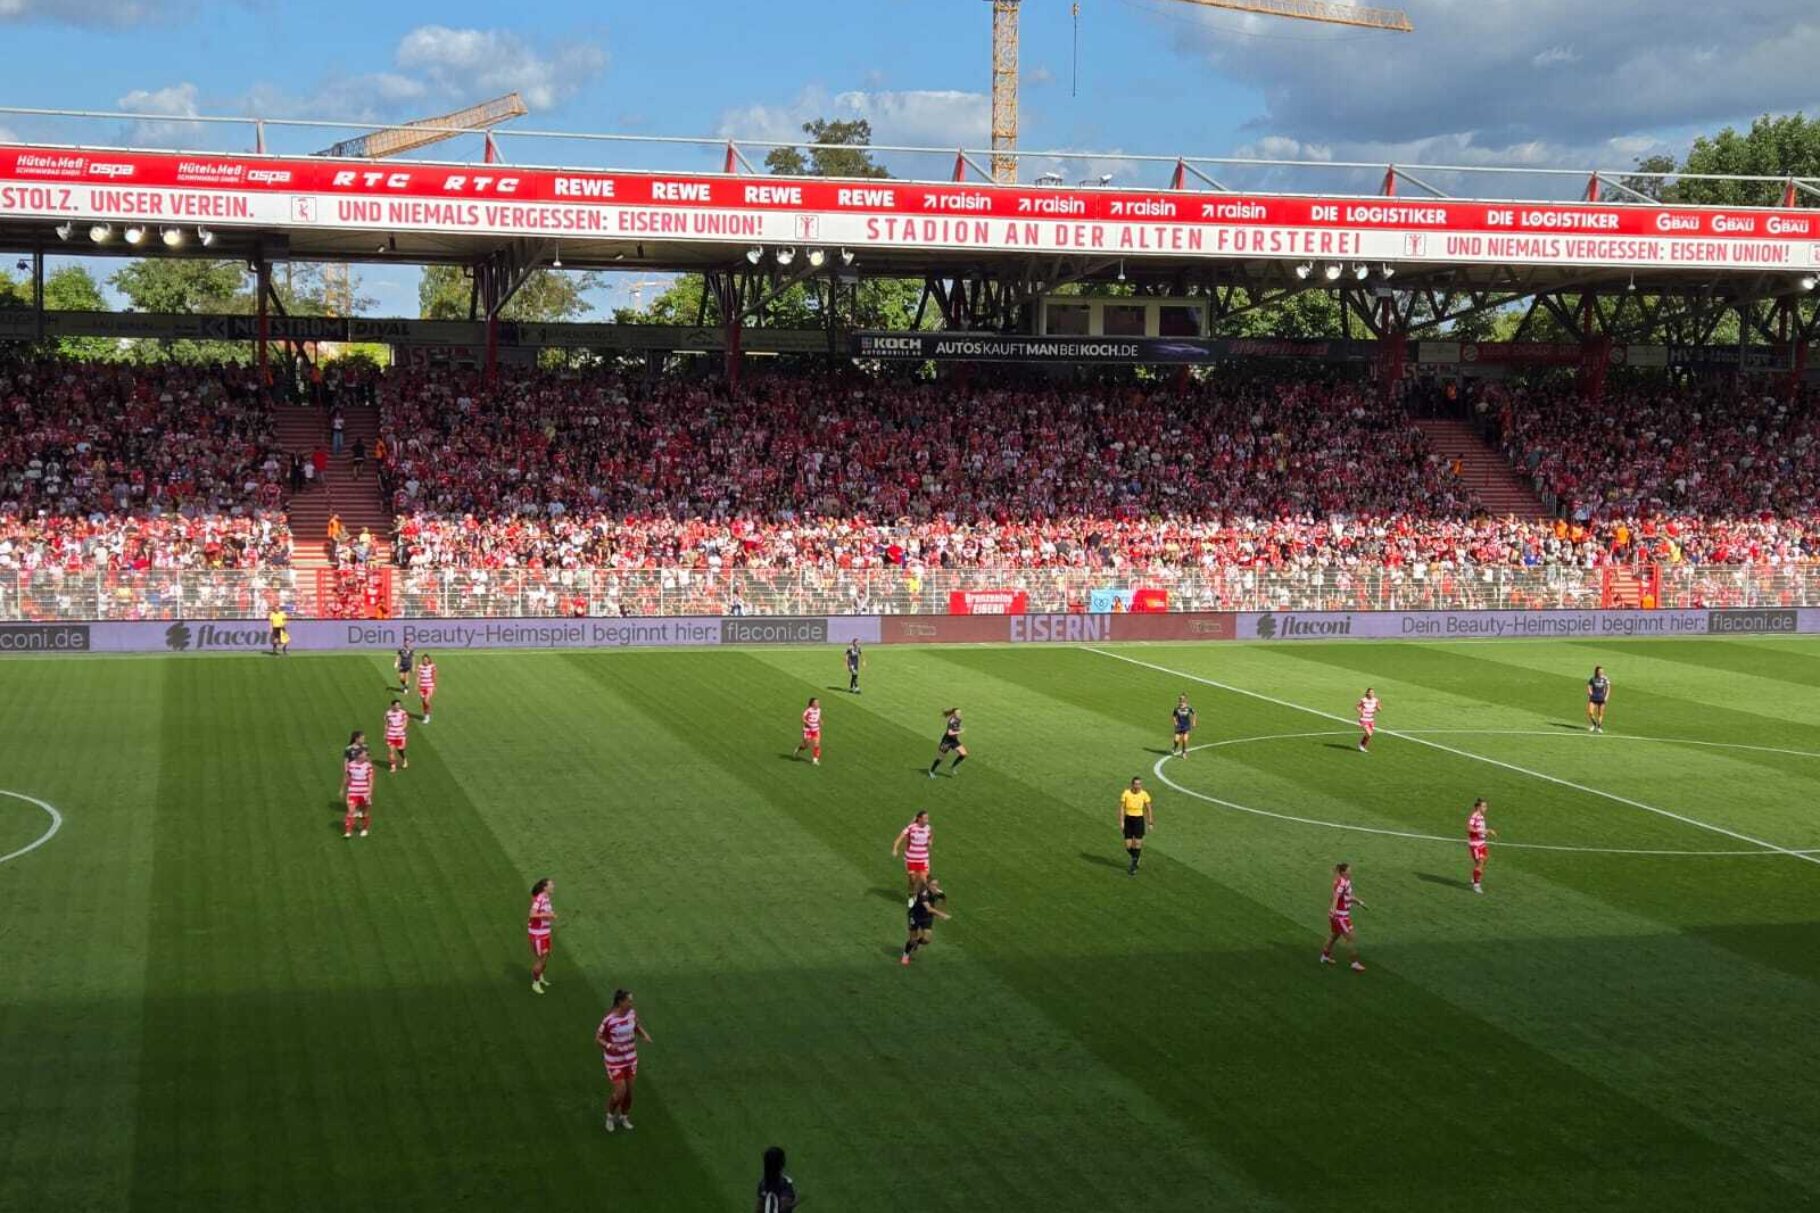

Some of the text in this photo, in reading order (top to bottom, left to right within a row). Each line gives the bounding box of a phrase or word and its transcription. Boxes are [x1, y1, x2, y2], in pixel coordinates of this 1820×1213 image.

[332, 170, 412, 188] RTC
[443, 175, 520, 192] RTC
[554, 178, 615, 198] REWE
[652, 181, 711, 201] REWE
[744, 185, 803, 204] REWE
[838, 188, 895, 207] REWE
[0, 187, 255, 218] STOLZ. UNSER VEREIN.
[939, 192, 992, 211] raisin
[1034, 196, 1085, 215] raisin
[1126, 197, 1176, 217] raisin
[1216, 201, 1267, 220] raisin
[338, 199, 763, 235] UND NIEMALS VERGESSEN: EISERN UNION!
[1310, 205, 1447, 225] DIE LOGISTIKER
[1487, 210, 1619, 229] DIE LOGISTIKER
[866, 217, 1360, 255] STADION AN DER ALTEN FÖRSTEREI
[1446, 236, 1790, 263] UND NIEMALS VERGESSEN: EISERN UNION!
[874, 337, 922, 350] KOCH
[935, 341, 1138, 357] AUTOSKAUFTMANBEIKOCH.DE
[347, 620, 823, 647] Dein Beauty-Heimspiel beginnt hier: flaconi.de
[1010, 615, 1110, 642] EISERN!
[1281, 615, 1351, 638] flaconi
[1402, 612, 1793, 636] Dein Beauty-Heimspiel beginnt hier: flaconi.de
